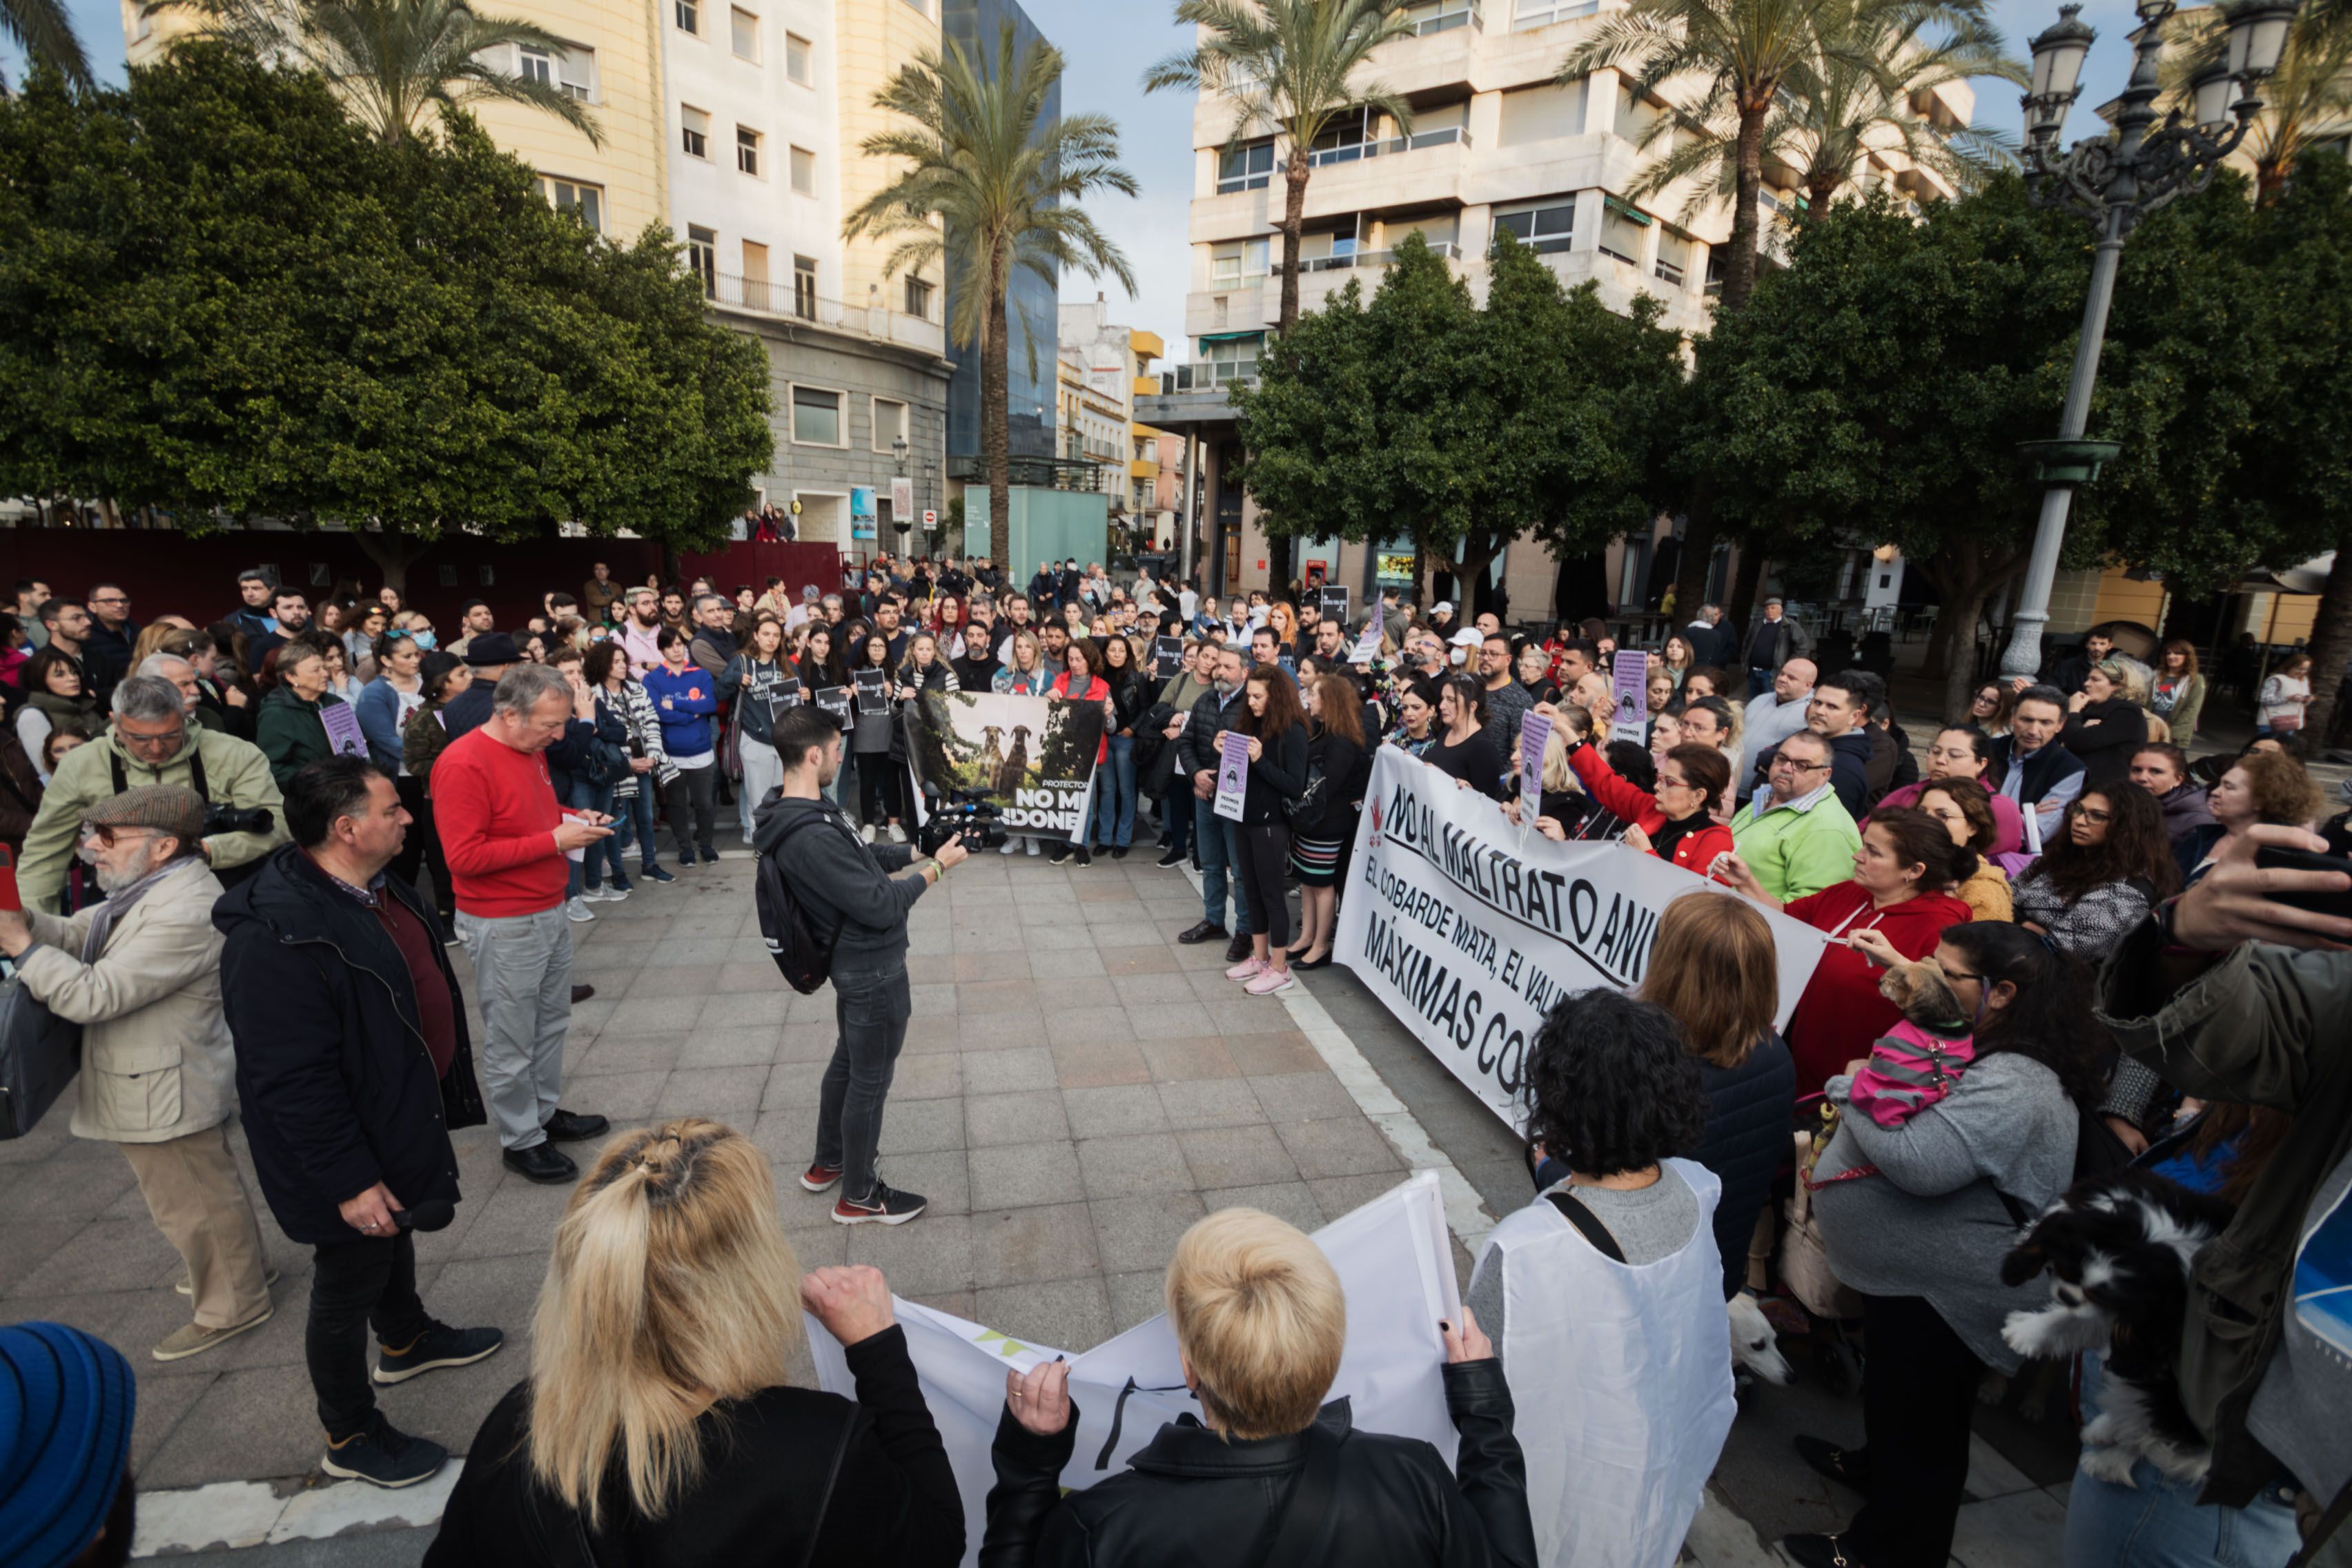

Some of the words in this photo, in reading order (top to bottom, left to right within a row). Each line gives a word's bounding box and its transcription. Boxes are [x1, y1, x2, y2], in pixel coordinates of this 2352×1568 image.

[758, 671, 774, 680] YORK
[1617, 727, 1639, 736] PEDIMOS
[1017, 788, 1055, 808] NO
[1058, 790, 1085, 811] M
[1221, 795, 1239, 805] PEDIMOS
[1219, 803, 1237, 813] JUSTICIA
[1386, 783, 1417, 843] NO
[1421, 804, 1441, 865] AL
[1442, 821, 1598, 945] MALTRATO
[1594, 892, 1661, 983] ANI
[1365, 854, 1378, 890] EL
[1381, 867, 1454, 939] COBARDE
[1451, 914, 1497, 981] MATA,
[1501, 948, 1524, 993] EL
[1364, 910, 1482, 1051] MÁXIMAS
[1477, 1011, 1535, 1101] CO
